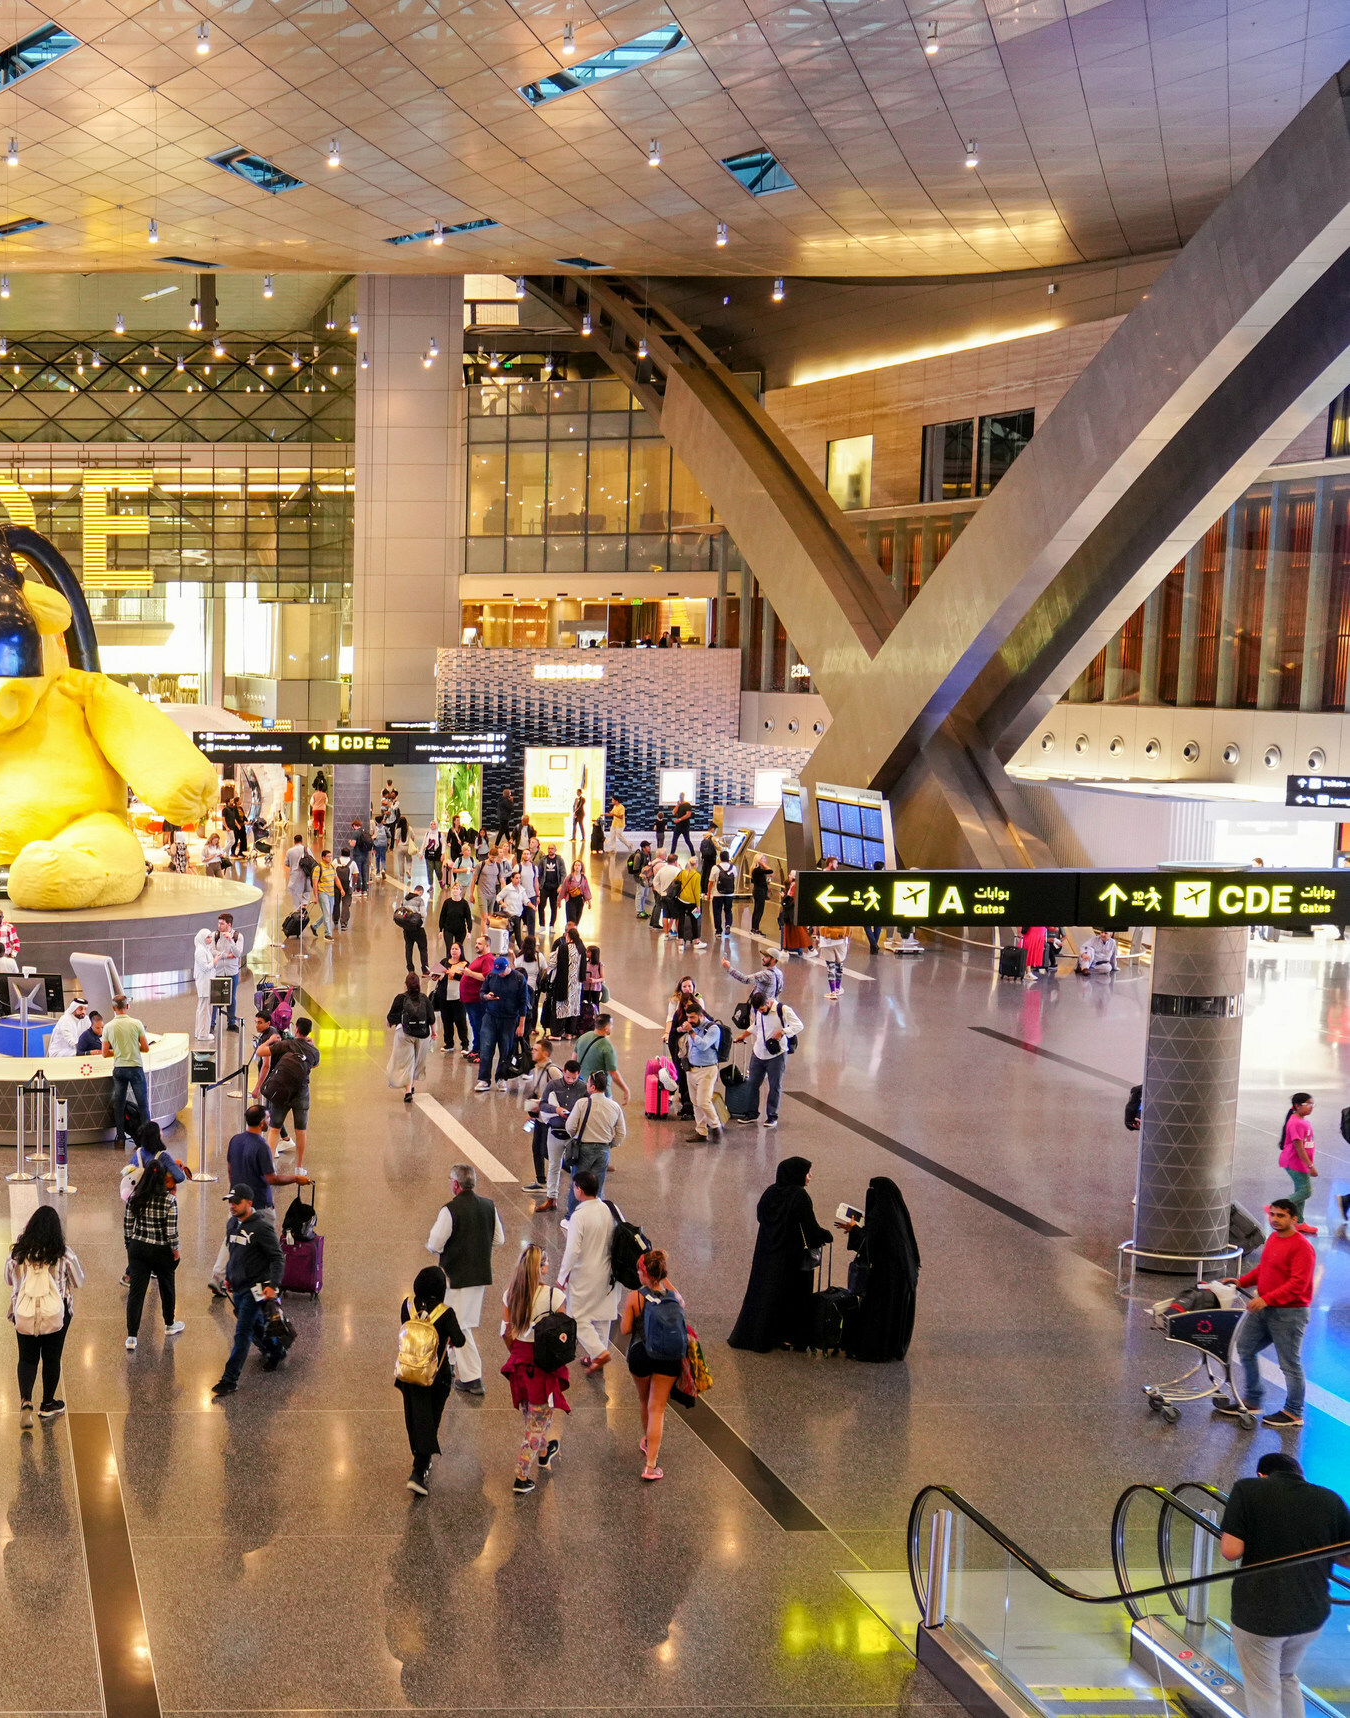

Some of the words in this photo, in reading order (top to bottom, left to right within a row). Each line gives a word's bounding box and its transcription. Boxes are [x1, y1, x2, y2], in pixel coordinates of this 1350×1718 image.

[341, 736, 374, 750] CDE
[853, 890, 861, 900] 3
[938, 885, 965, 914] A
[974, 886, 1010, 901] بوابات
[1132, 891, 1144, 900] 10
[1218, 885, 1293, 915] CDE
[1300, 886, 1335, 900] بوابات
[973, 904, 1005, 914] Gates
[1299, 903, 1331, 914] Gates
